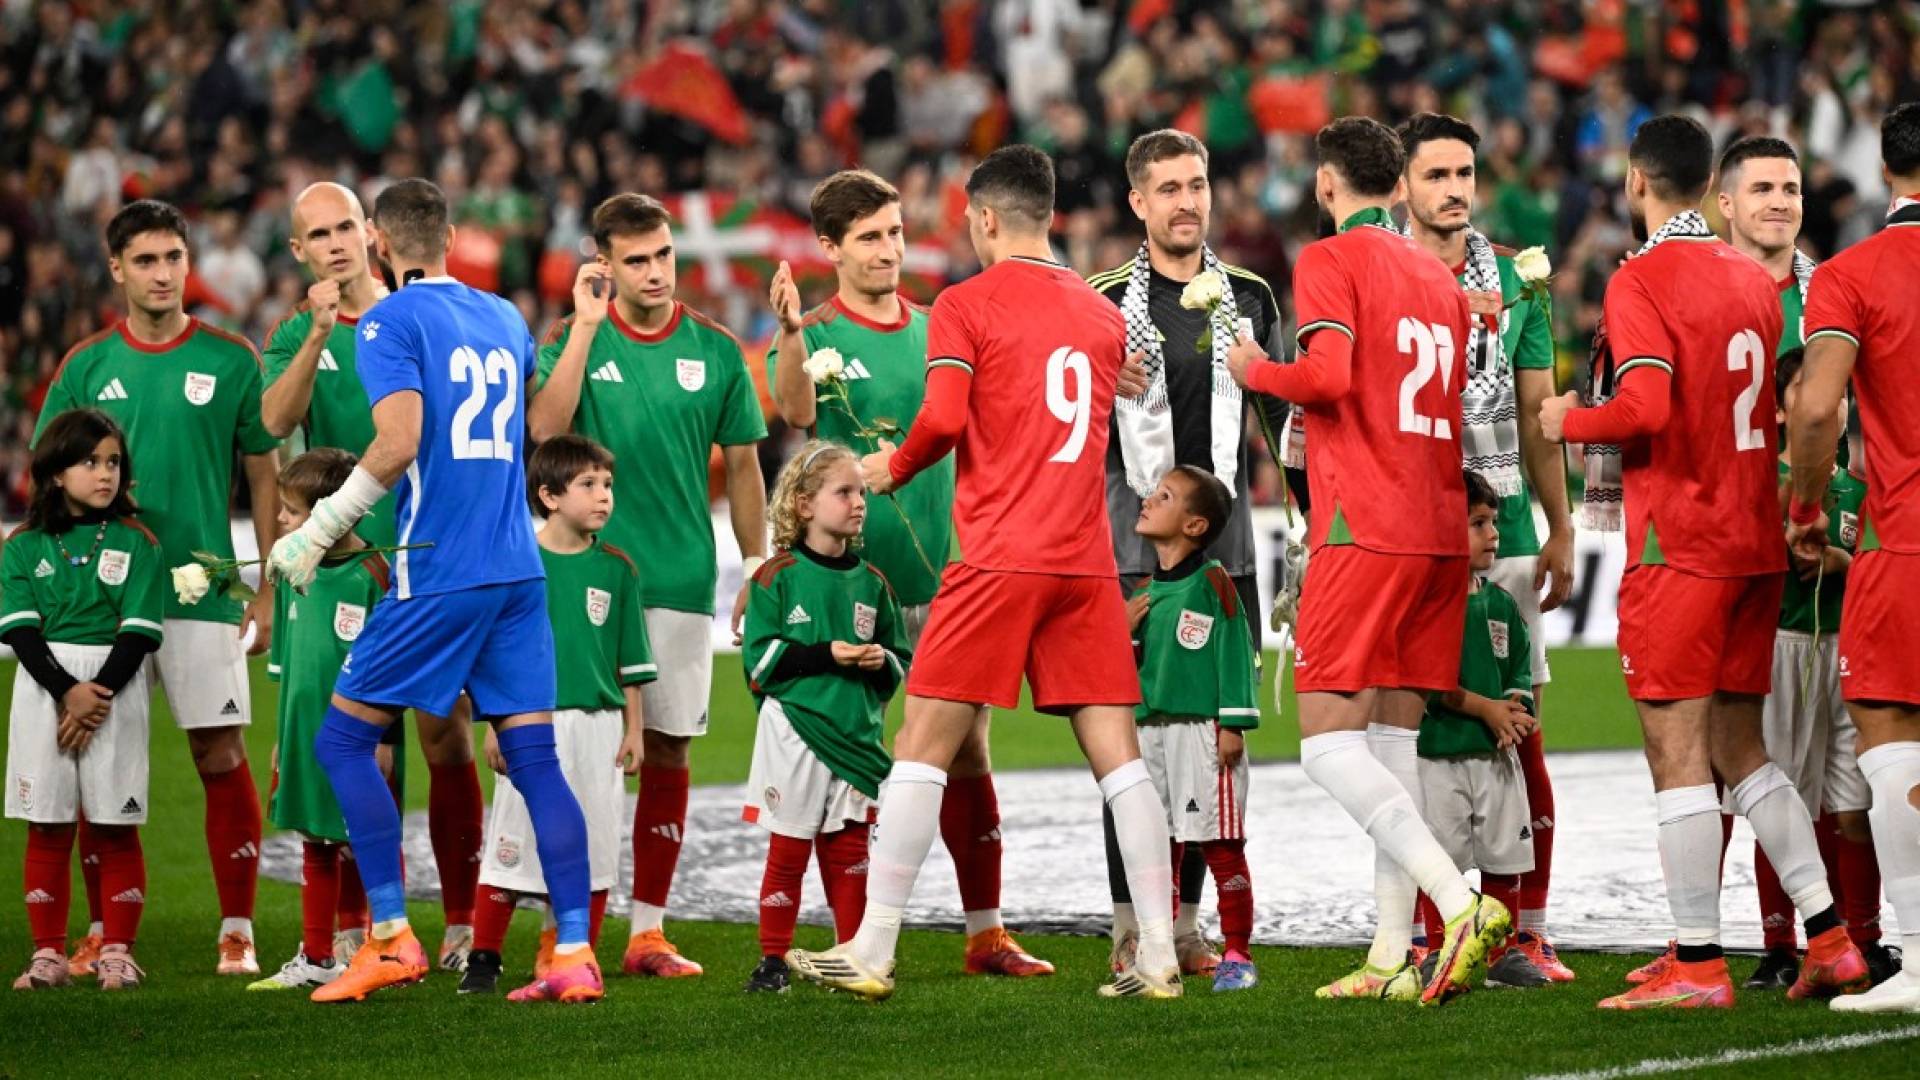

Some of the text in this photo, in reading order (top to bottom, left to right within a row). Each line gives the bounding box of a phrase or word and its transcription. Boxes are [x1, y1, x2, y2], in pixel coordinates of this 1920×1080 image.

[449, 345, 517, 463] 22
[1045, 345, 1092, 463] 9
[1727, 327, 1766, 452] 2
